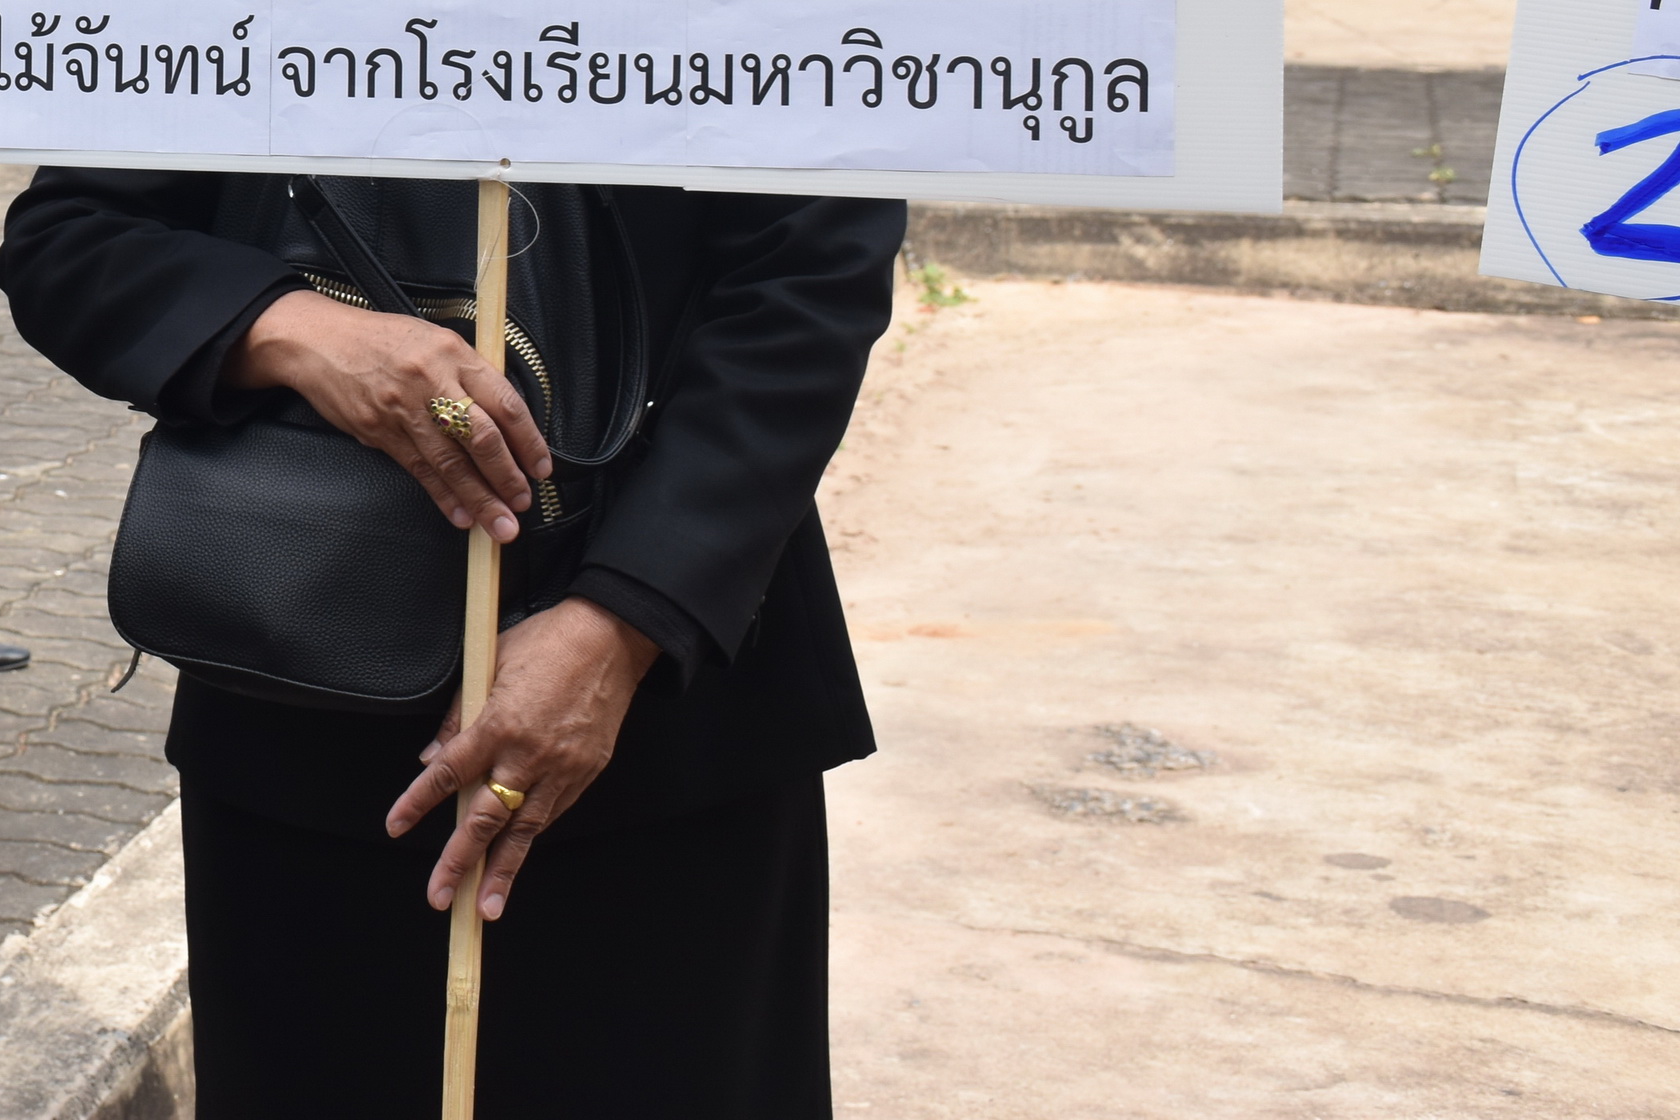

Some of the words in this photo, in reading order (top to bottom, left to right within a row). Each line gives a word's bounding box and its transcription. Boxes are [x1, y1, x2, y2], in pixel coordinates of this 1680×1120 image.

[277, 18, 1149, 144] จากโรงเรียนมหาวิชานุกูล
